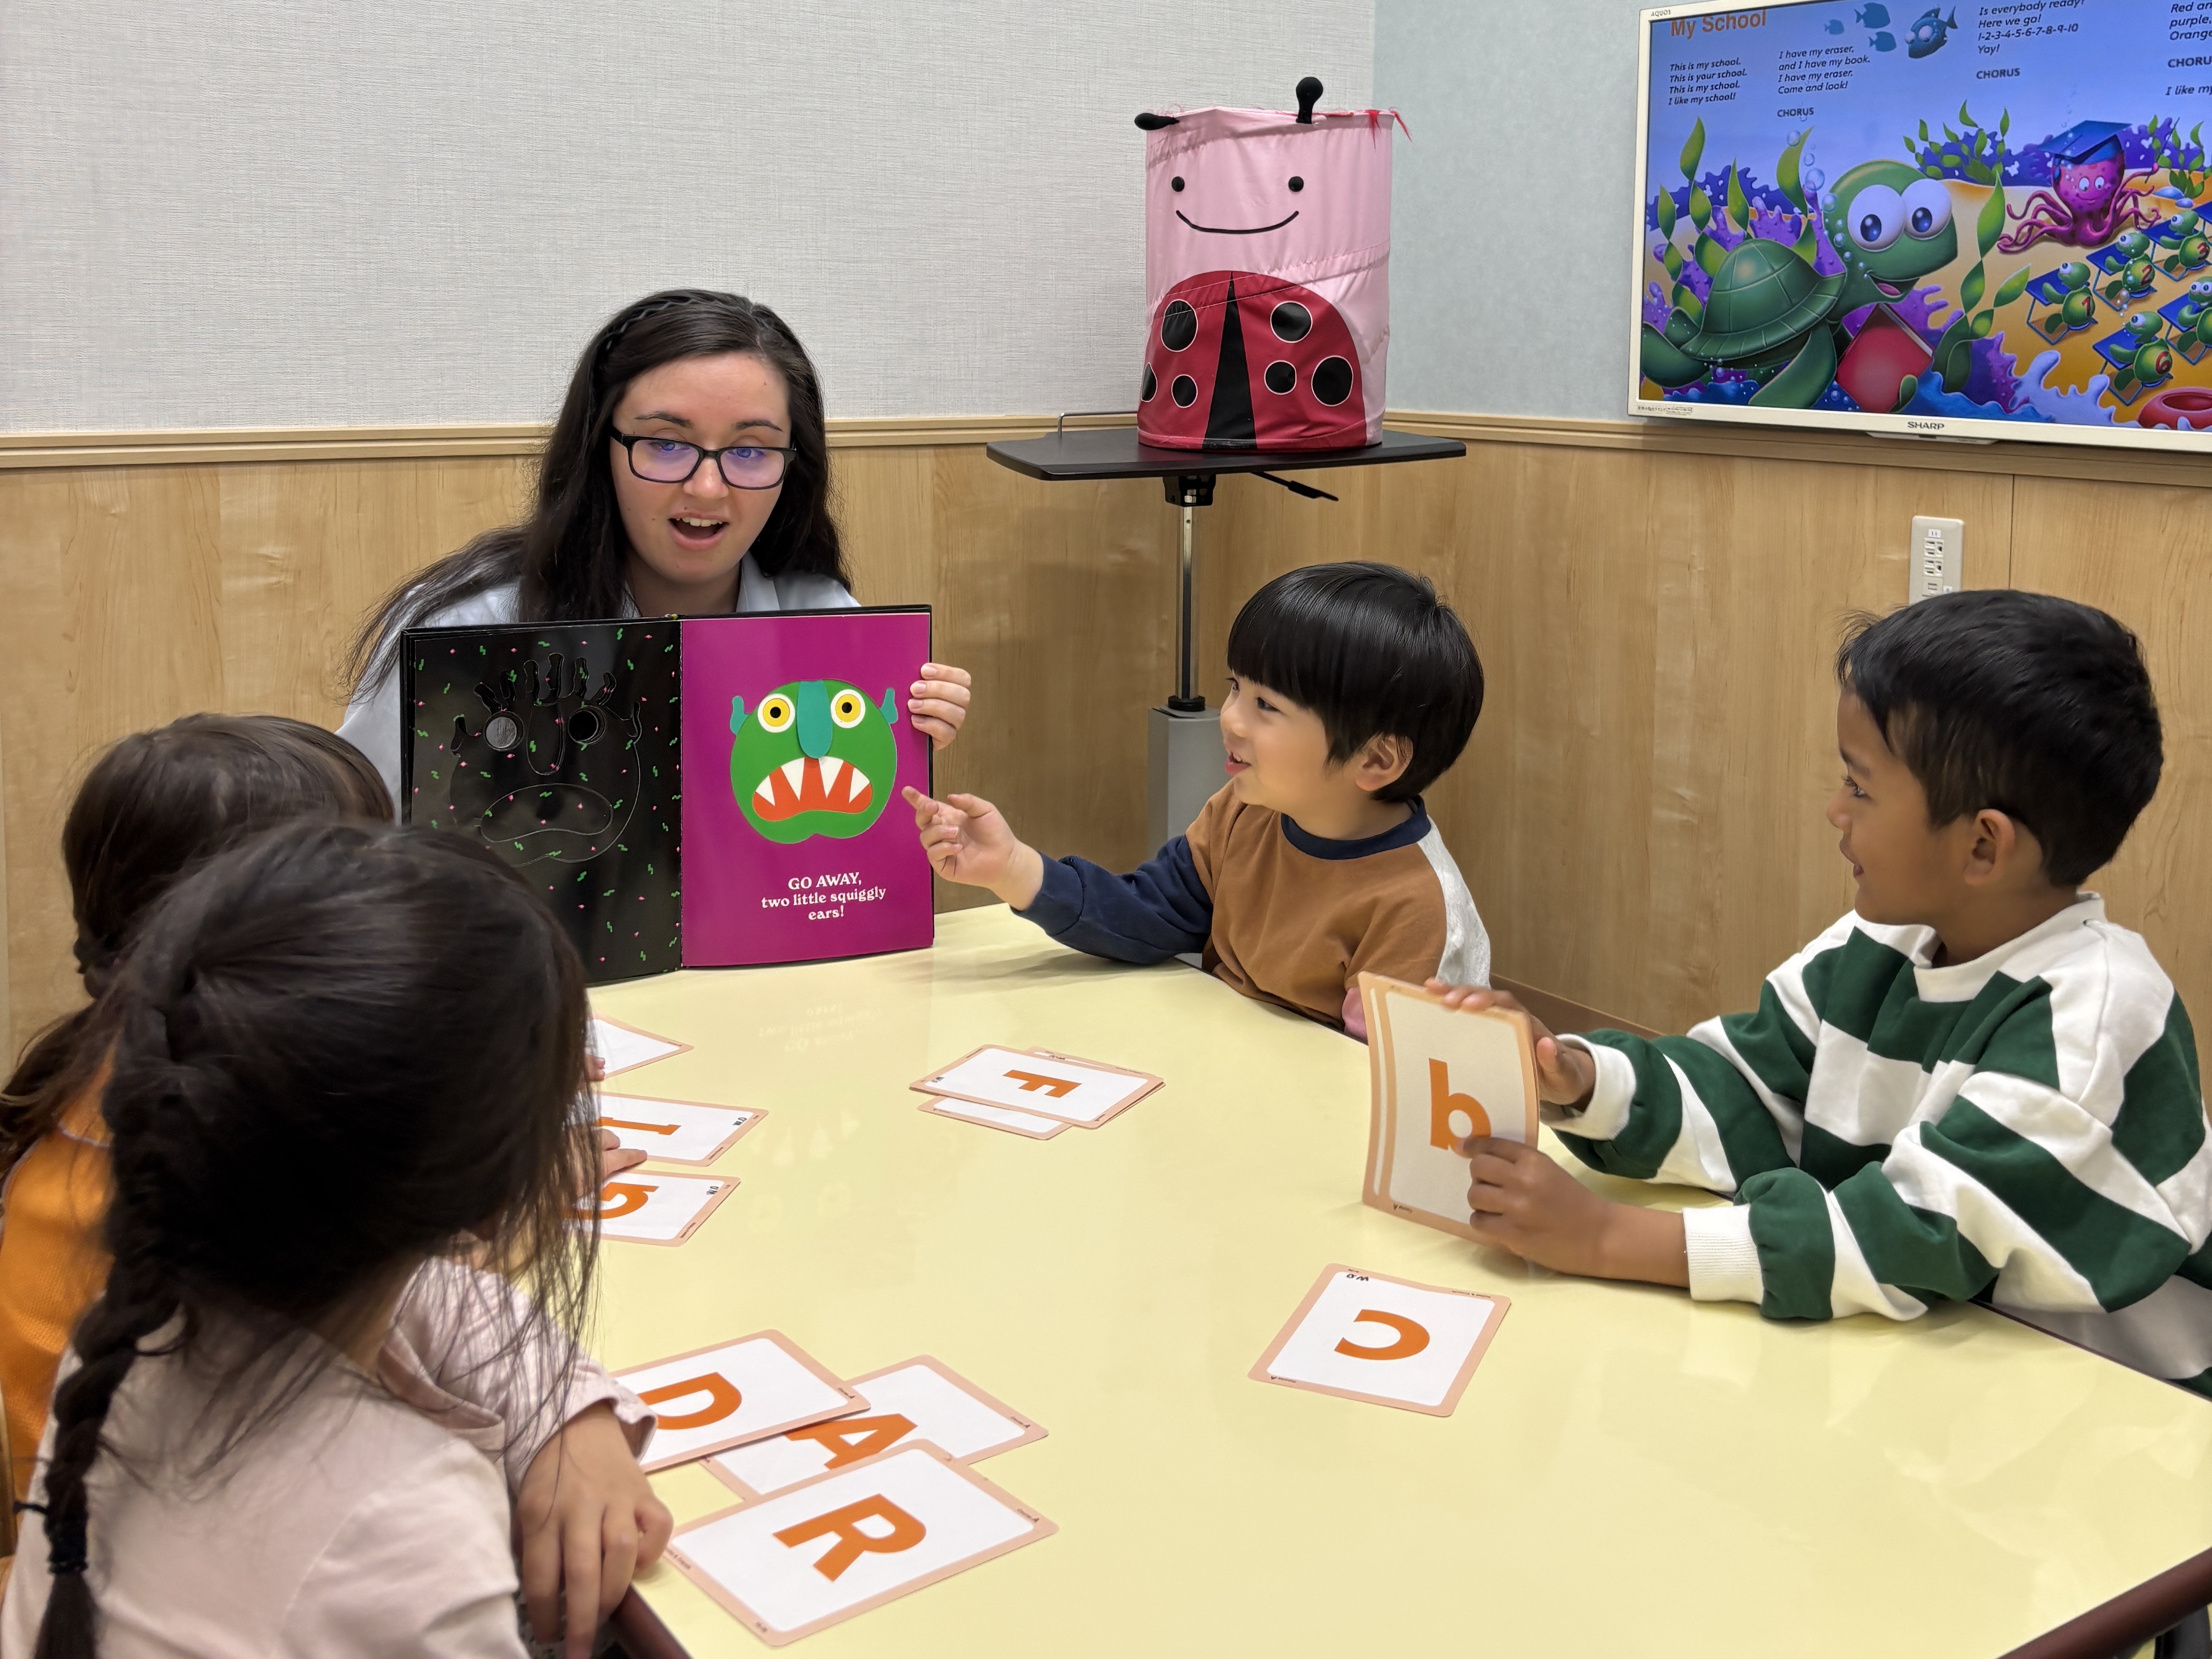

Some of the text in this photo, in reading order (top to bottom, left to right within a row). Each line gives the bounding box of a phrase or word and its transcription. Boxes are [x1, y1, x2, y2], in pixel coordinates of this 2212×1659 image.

[1979, 7, 1988, 16] Is
[1991, 1, 2046, 15] everybody
[2171, 2, 2194, 13] Red
[1671, 9, 1766, 40] My School
[1979, 20, 2002, 28] Here
[2023, 14, 2042, 26] go!
[1978, 23, 2079, 41] 1-2-3-4-5-6-7-8-9-10
[1779, 51, 1783, 59] I
[1785, 50, 1807, 59] have
[1809, 49, 1823, 58] my
[1978, 44, 2000, 56] Yay!
[1670, 57, 1741, 72] This is my school.
[1779, 55, 1870, 71] and I have my book.
[1670, 68, 1747, 83] This is your school.
[1778, 70, 1853, 83] I have my eraser.
[1976, 68, 2020, 79] CHORUS
[1669, 80, 1740, 94] This is my school.
[1778, 81, 1848, 94] Come and look!
[2165, 86, 2172, 96] I
[2175, 85, 2194, 95] like
[1674, 97, 1688, 105] like
[1690, 97, 1703, 105] my
[1705, 92, 1736, 102] school!
[1777, 107, 1814, 117] CHORUS
[2198, 242, 2209, 260] 3
[2141, 264, 2152, 285] 2
[2082, 296, 2091, 317] 1
[2156, 351, 2171, 374] 6
[1907, 421, 1944, 430] SHARP
[788, 872, 861, 890] GO AWAY,
[761, 886, 886, 909] two little squiggly
[808, 905, 844, 920] ears!
[1002, 1070, 1083, 1098] F
[637, 1372, 742, 1430] D
[782, 1413, 918, 1470] A
[772, 1493, 927, 1582] R
